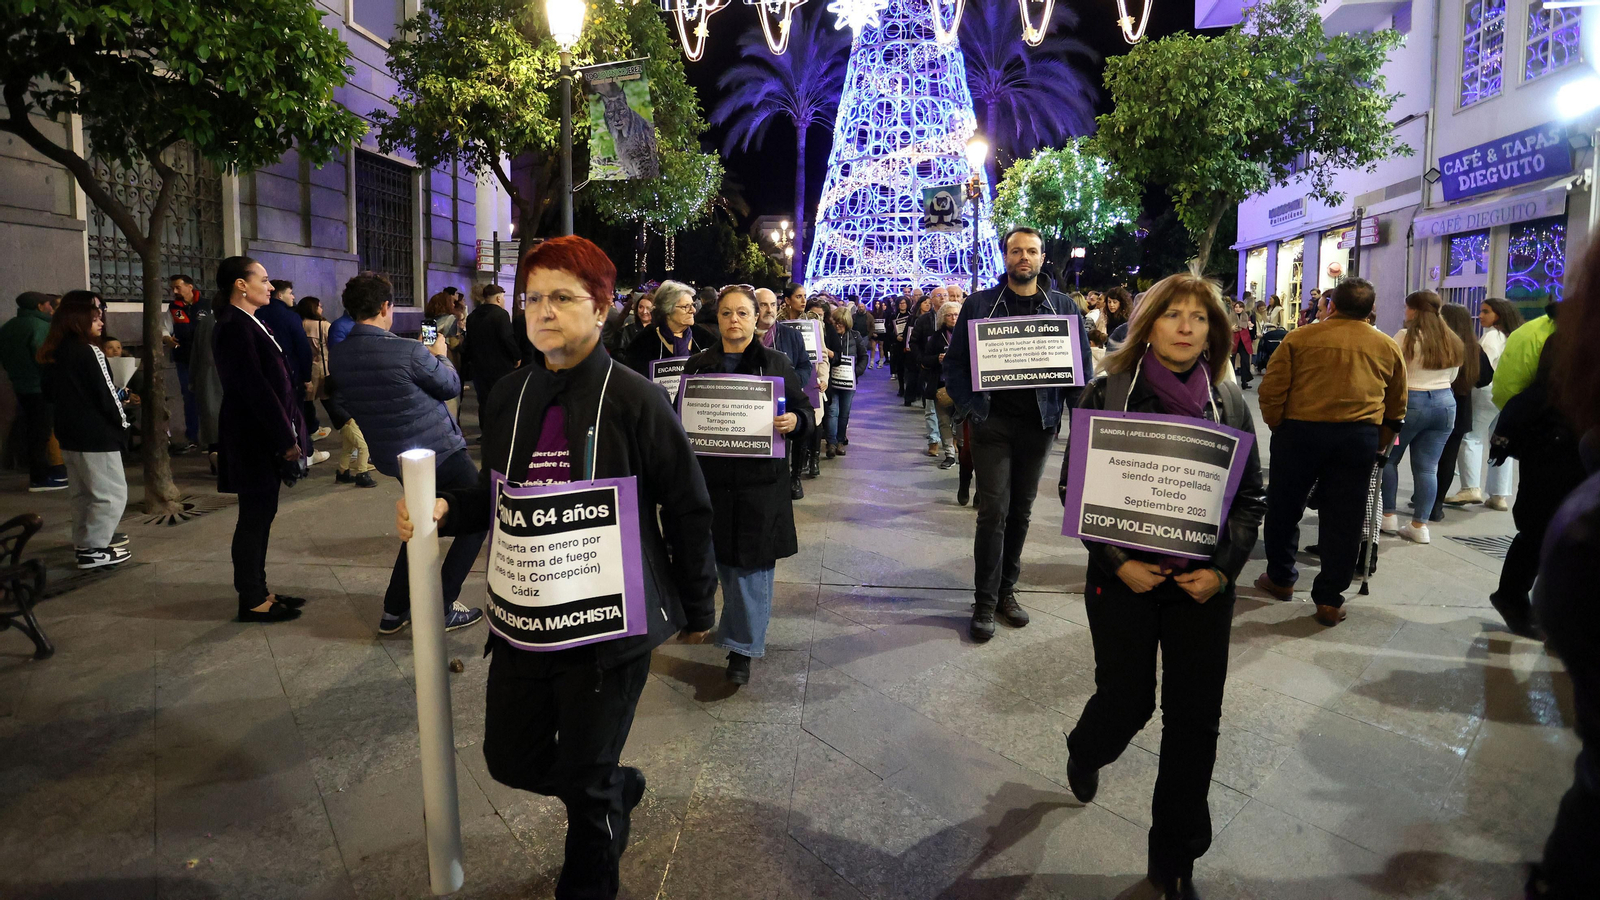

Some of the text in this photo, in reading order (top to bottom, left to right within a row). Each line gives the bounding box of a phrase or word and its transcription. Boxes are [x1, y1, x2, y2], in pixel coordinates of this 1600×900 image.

[1444, 127, 1560, 175] CAFÉ & TAPAS
[1458, 154, 1546, 191] DIEGUITO
[1431, 201, 1537, 235] CAFÉ DIEGUITO
[987, 324, 1059, 335] MARIA 40 años
[982, 371, 1072, 383] STOP VIOLENCIA MACHISTA
[698, 424, 729, 433] Septiembre
[706, 417, 735, 425] Tarragona
[695, 438, 730, 447] VIOLENCIA
[731, 440, 770, 449] MACHISTA
[1100, 428, 1125, 436] SANDRA
[1129, 431, 1166, 440] APELLIDOS
[1167, 434, 1215, 448] DESCONOCIDOS
[1109, 456, 1159, 470] Asesinada
[1161, 465, 1181, 474] por
[1184, 468, 1196, 476] su
[1122, 471, 1212, 492] siendo atropellada.
[1151, 487, 1187, 500] Toledo
[532, 507, 557, 527] 64
[562, 503, 610, 523] años
[1124, 496, 1207, 518] Septiembre 2023
[1084, 513, 1216, 546] STOP VIOLENCIA MACHISTA
[530, 544, 545, 553] en
[548, 539, 579, 551] enero
[582, 535, 601, 547] por
[506, 556, 515, 566] de
[516, 559, 546, 568] arma
[549, 555, 563, 566] de
[566, 551, 597, 562] fuego
[507, 569, 515, 580] de
[517, 572, 526, 582] la
[529, 562, 601, 582] Concepción)
[511, 584, 540, 597] Cádiz
[493, 604, 622, 631] VIOLENCIA MACHISTA
